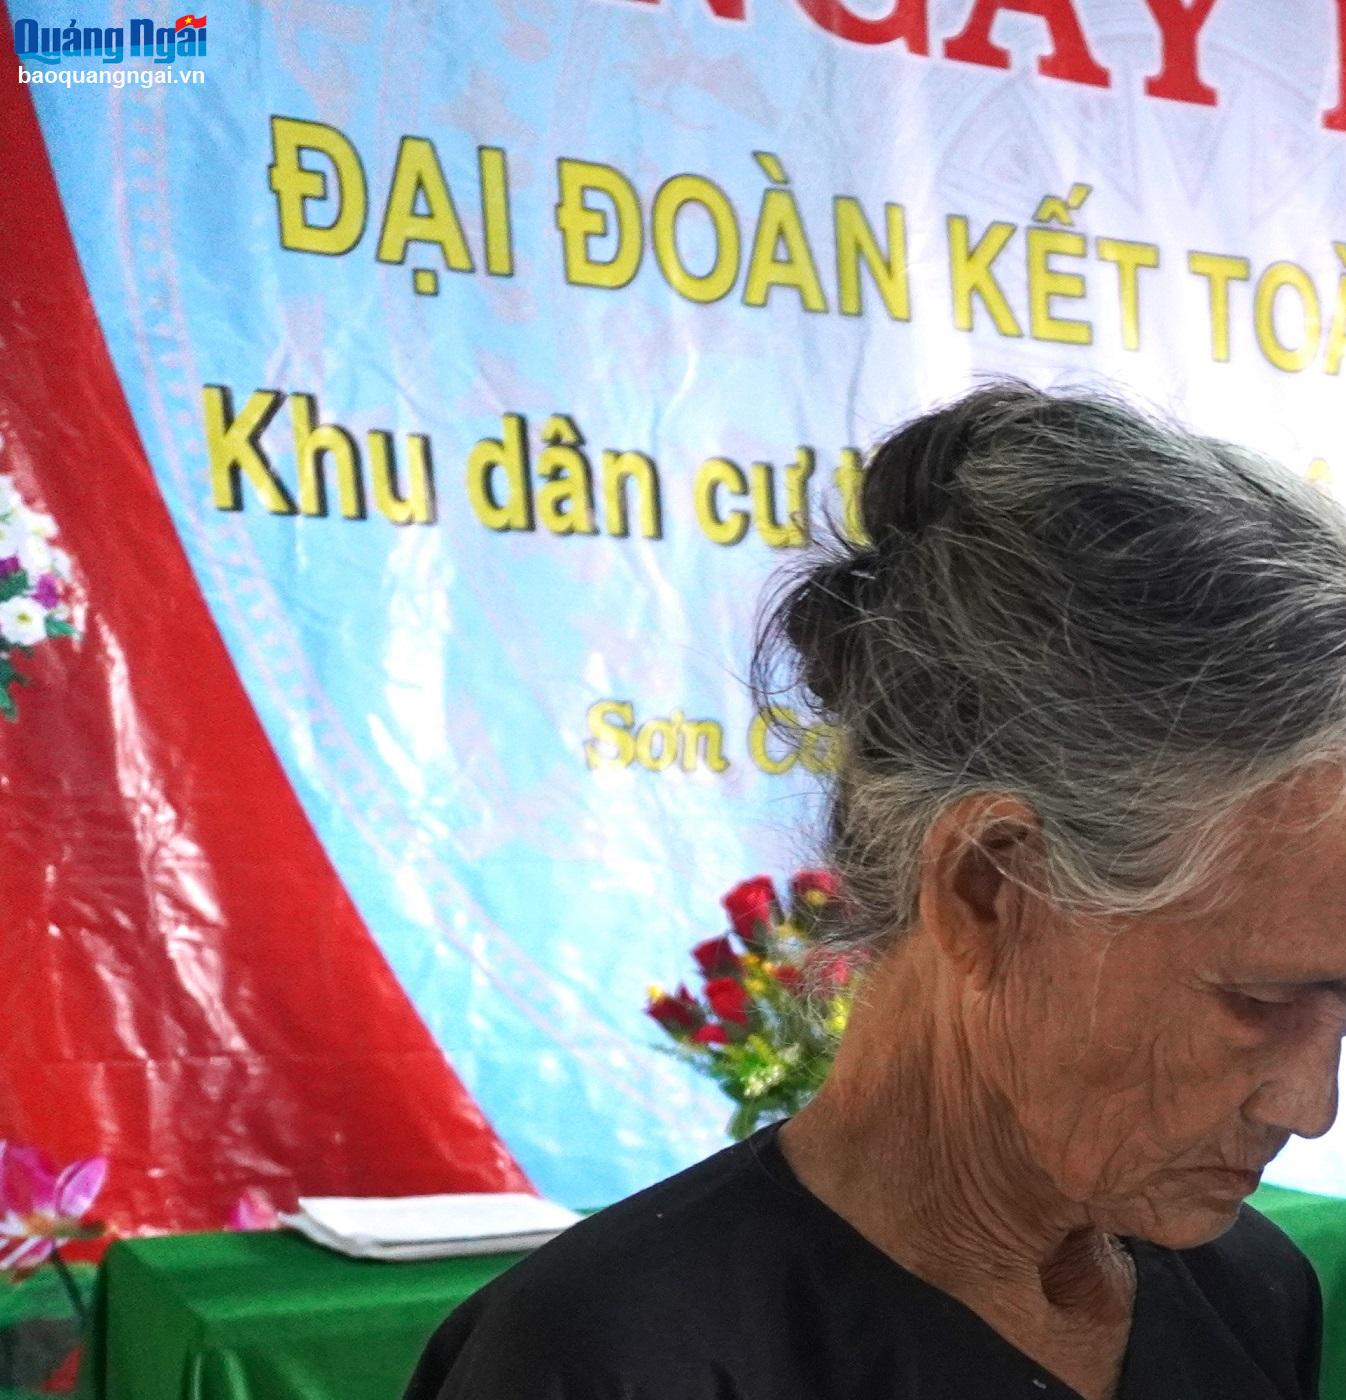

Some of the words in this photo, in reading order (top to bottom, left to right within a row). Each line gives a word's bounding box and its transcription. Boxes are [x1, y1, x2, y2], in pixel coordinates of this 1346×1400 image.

[267, 115, 515, 296] ĐẠI
[555, 151, 912, 323] ĐOÀN
[945, 182, 1160, 351] KẾT
[201, 382, 435, 526] Khu
[466, 411, 665, 541] dân
[692, 446, 816, 549] cư
[584, 699, 731, 775] Sơn
